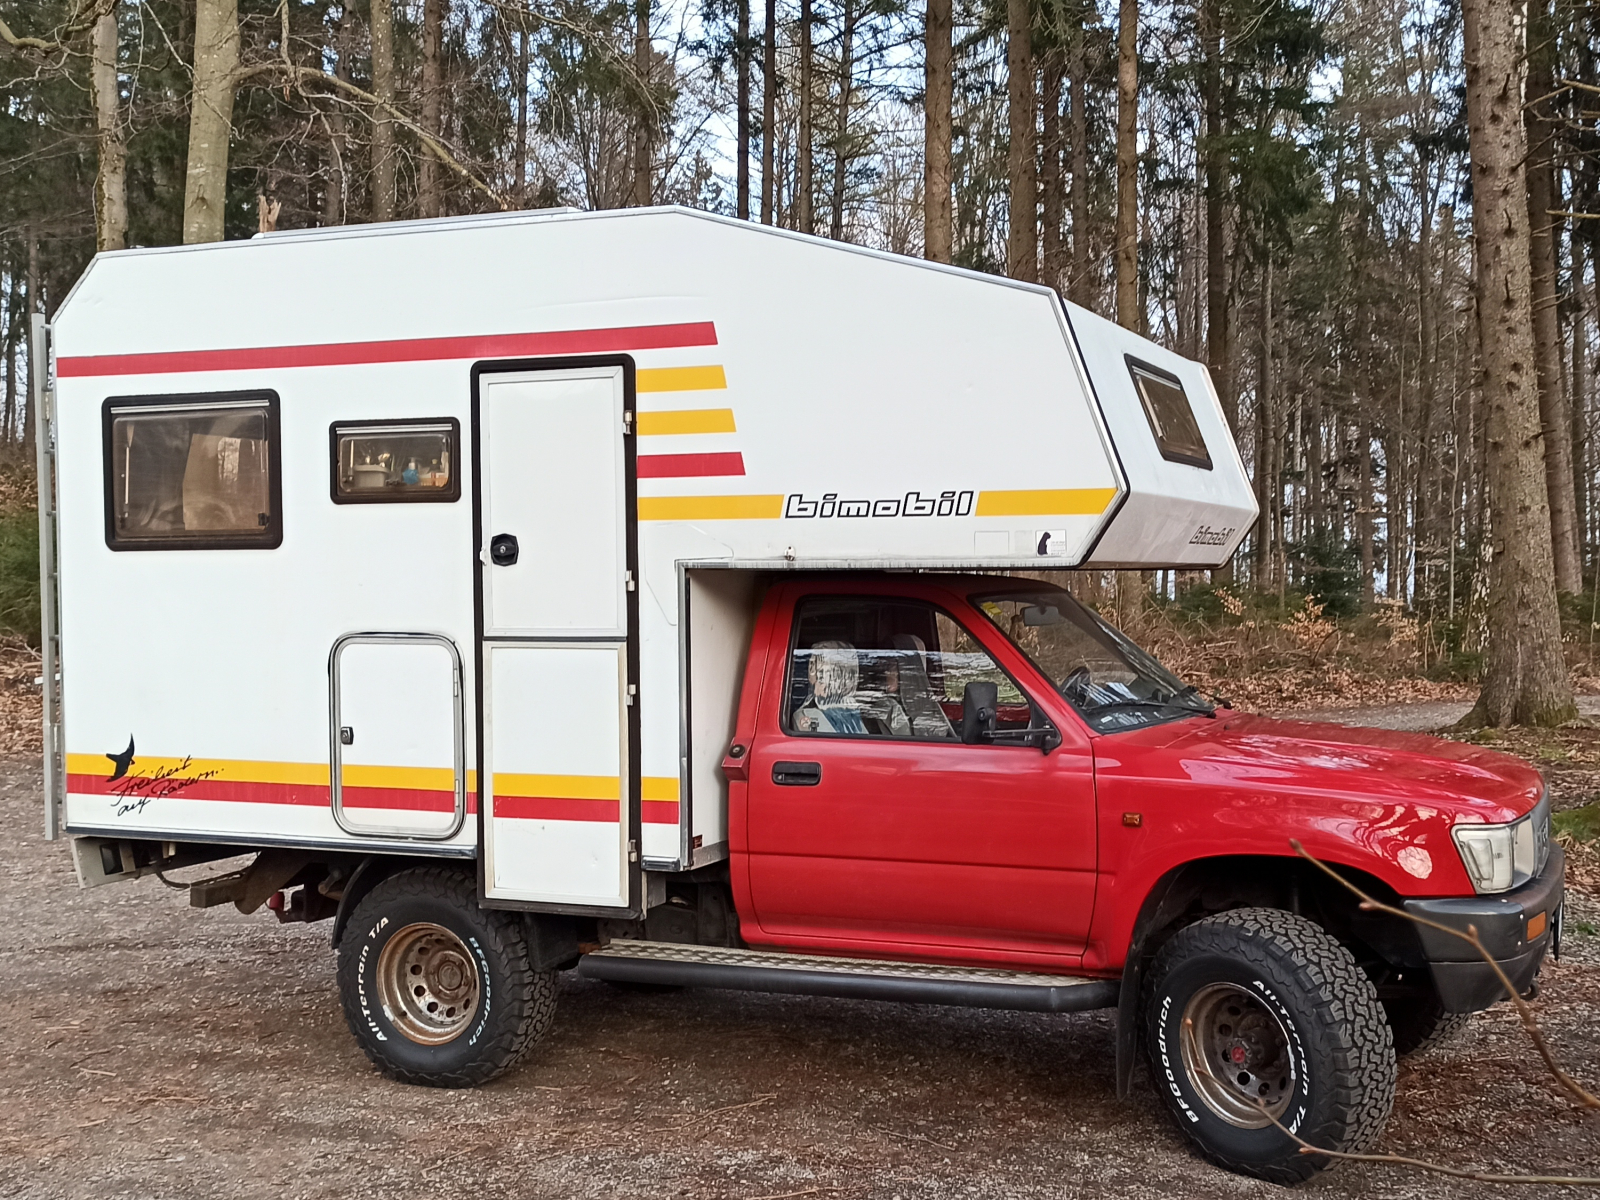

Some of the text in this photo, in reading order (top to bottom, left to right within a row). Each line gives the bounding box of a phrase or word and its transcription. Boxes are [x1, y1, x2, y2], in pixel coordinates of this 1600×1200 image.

[785, 490, 974, 519] bimobil
[117, 794, 151, 817] auf
[468, 936, 492, 1047] BFGoodrich
[1158, 995, 1200, 1124] BFGoodrich
